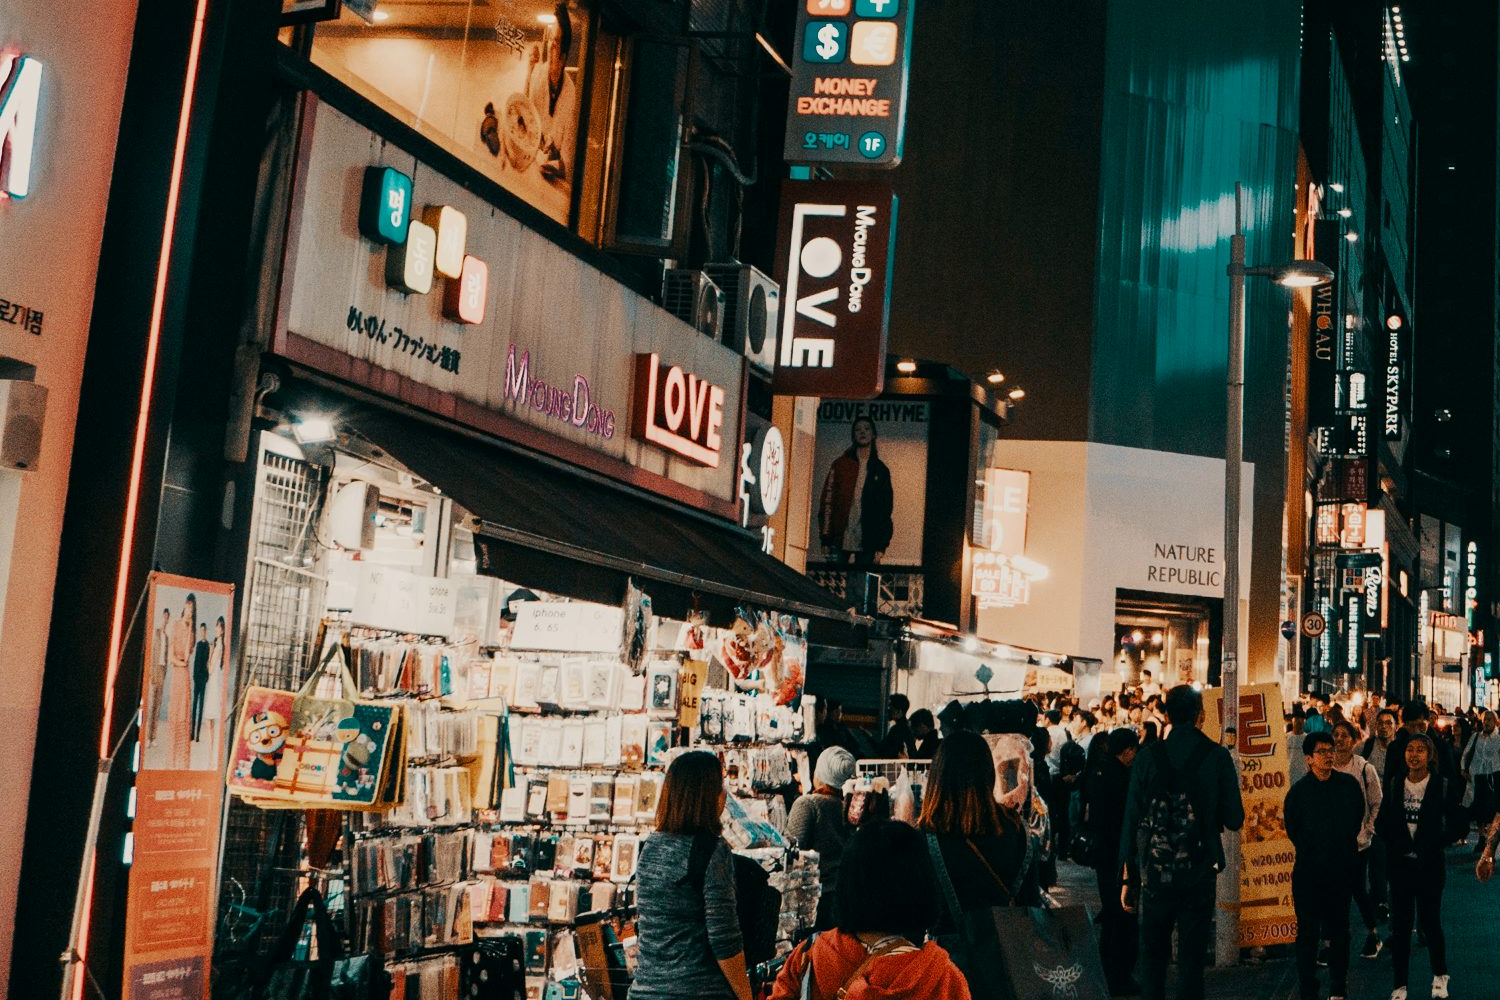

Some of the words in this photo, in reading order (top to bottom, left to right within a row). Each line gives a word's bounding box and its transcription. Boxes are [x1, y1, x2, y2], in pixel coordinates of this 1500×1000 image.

[814, 77, 877, 96] MONEY
[797, 97, 890, 117] EXCHANGE
[864, 137, 881, 152] 1F
[780, 203, 847, 368] LOVE
[1388, 332, 1398, 364] HOTEL
[646, 352, 726, 468] LOVE
[1386, 366, 1399, 435] SKYPARK
[1154, 543, 1216, 564] NATURE
[1147, 565, 1221, 587] REPUBLIC
[1306, 618, 1321, 631] 30
